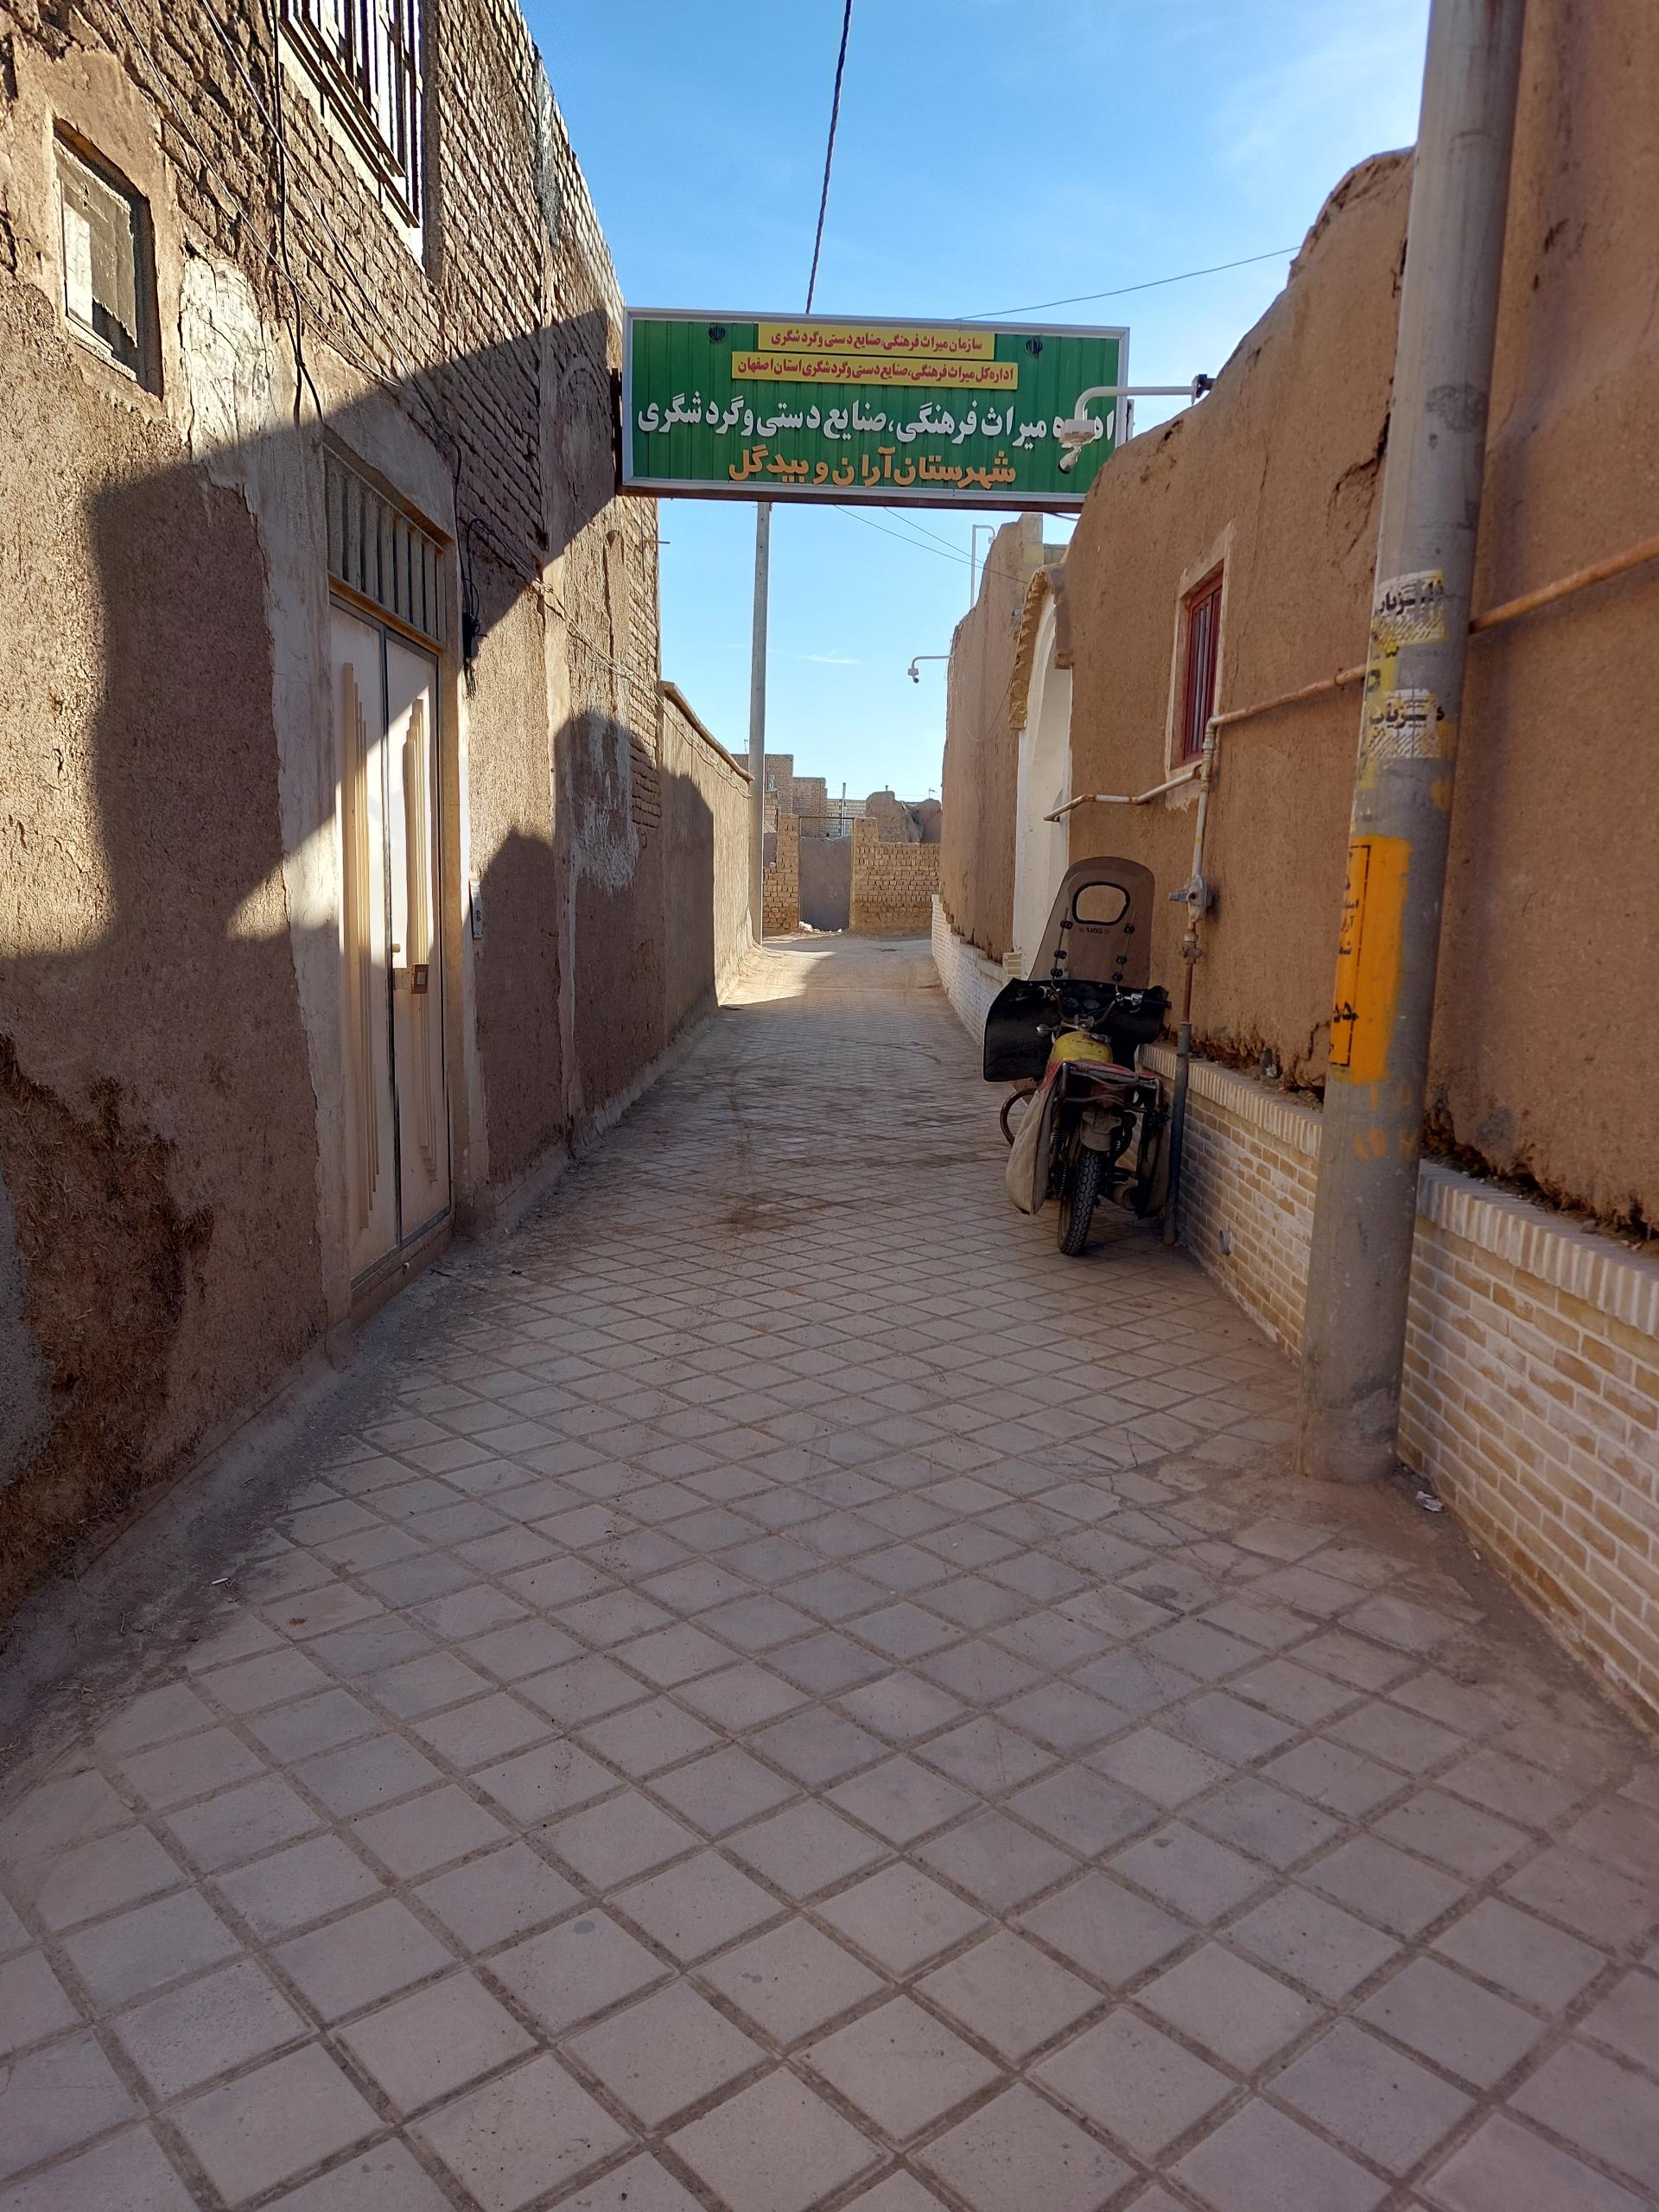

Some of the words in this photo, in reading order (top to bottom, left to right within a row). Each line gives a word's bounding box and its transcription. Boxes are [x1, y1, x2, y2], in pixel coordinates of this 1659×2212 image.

[824, 333, 853, 347] دستی
[853, 332, 881, 349] صنایع
[920, 334, 948, 352] میراث
[949, 337, 982, 353] سازمان
[738, 356, 773, 373] اصفهان
[773, 358, 802, 374] استان
[852, 364, 880, 378] دستی
[880, 363, 908, 379] صنایع
[947, 365, 975, 383] میراث
[756, 401, 821, 437] دستی
[823, 398, 887, 441] صنایع
[981, 404, 1047, 450] میراث
[728, 443, 810, 483] بیدگل
[832, 446, 896, 487] آران
[893, 449, 1016, 490] شهرستان
[813, 460, 829, 485] و
